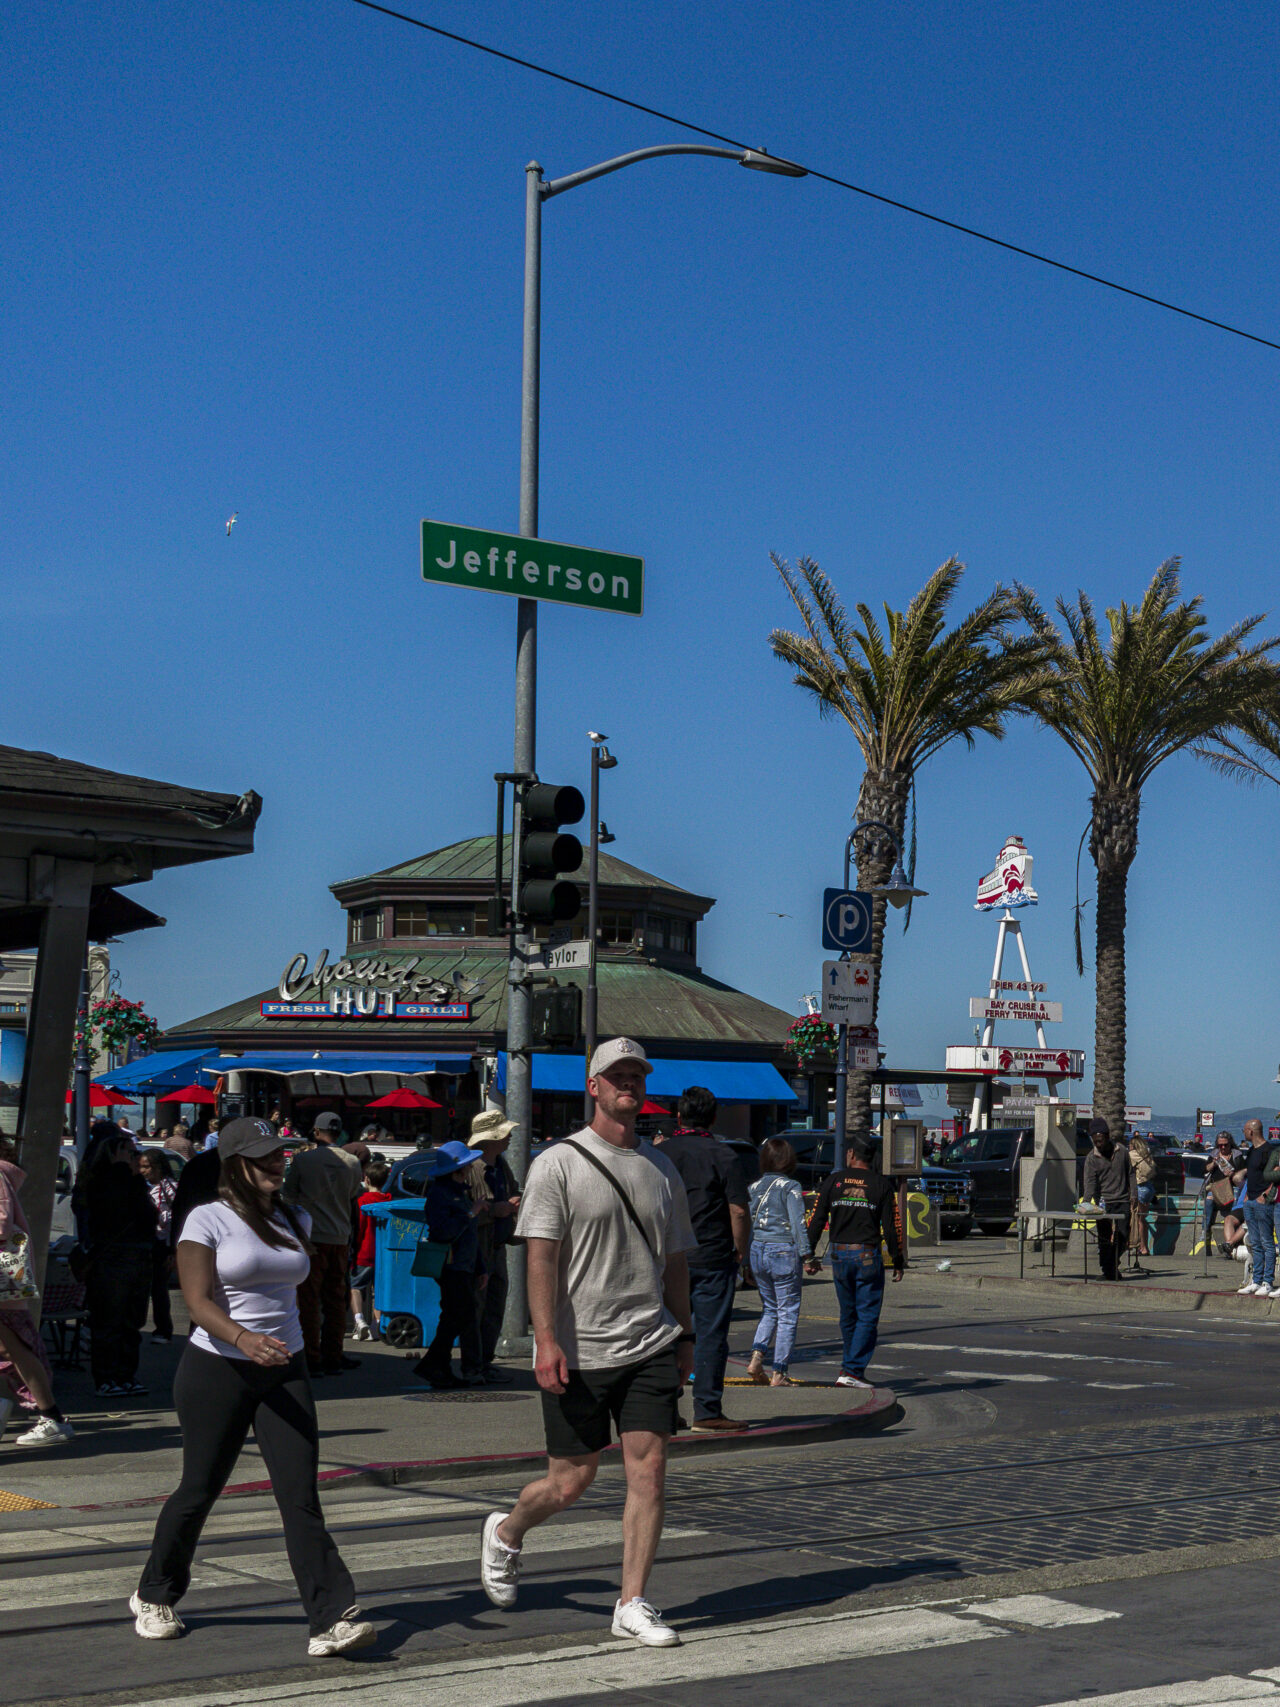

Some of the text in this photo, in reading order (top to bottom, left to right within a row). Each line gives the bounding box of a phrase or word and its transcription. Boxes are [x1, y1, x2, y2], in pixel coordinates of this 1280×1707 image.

[435, 539, 629, 599] Jefferson
[543, 947, 578, 968] Taylor
[278, 948, 449, 1002] Chowder
[995, 980, 1045, 993] PIER 43 1/2
[329, 985, 402, 1015] HUT
[828, 993, 869, 1004] Fisherman's
[267, 1004, 464, 1015] FRESH GRILL
[828, 1003, 849, 1012] Wharf
[990, 1000, 1005, 1010] BAY
[1007, 1001, 1037, 1011] CRUISE
[984, 1009, 1051, 1021] FERRY TERMINAL
[857, 1048, 869, 1056] ANY
[1034, 1053, 1056, 1061] WHITE
[856, 1056, 870, 1065] TIME
[1025, 1061, 1045, 1070] FLEET
[1005, 1098, 1022, 1107] PAY
